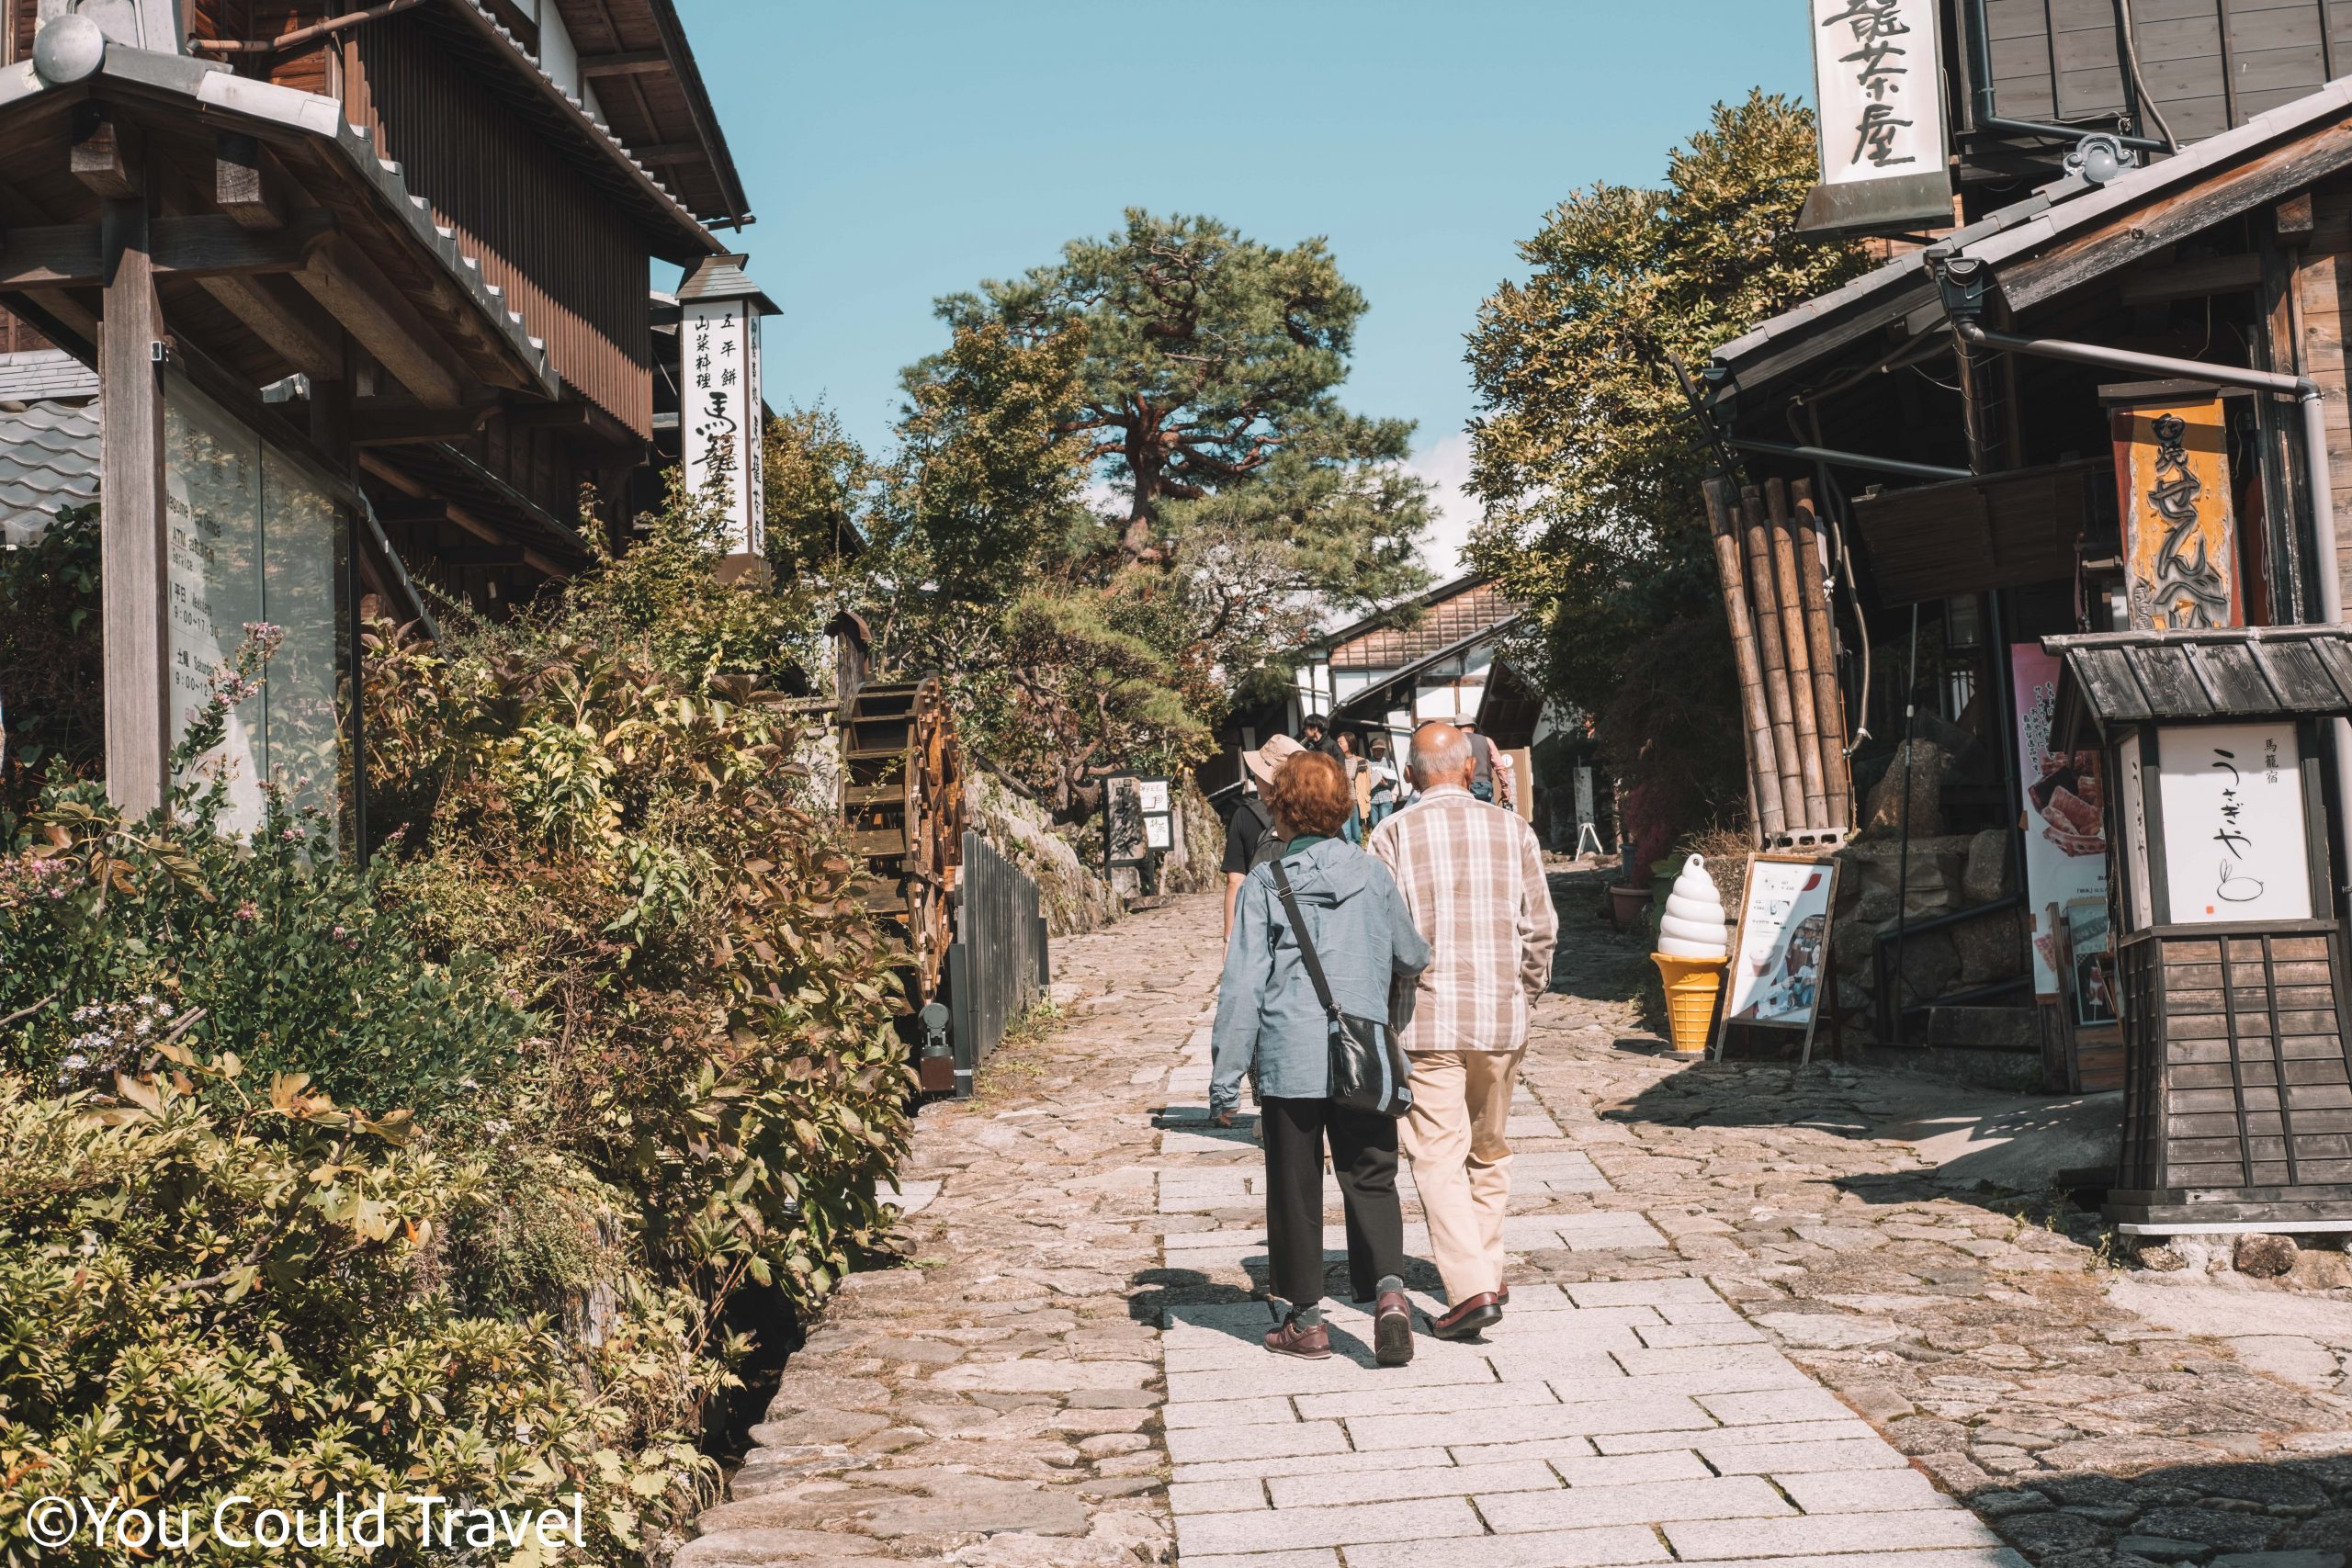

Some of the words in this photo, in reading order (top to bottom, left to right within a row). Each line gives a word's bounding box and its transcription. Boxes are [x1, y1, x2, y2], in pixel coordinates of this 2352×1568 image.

[695, 315, 711, 389] 山菜料理
[720, 313, 738, 387] 五平餅
[173, 526, 186, 547] ATM
[174, 582, 187, 604] 平日
[2264, 739, 2278, 784] 馬籠宿
[2211, 748, 2252, 860] うさぎや
